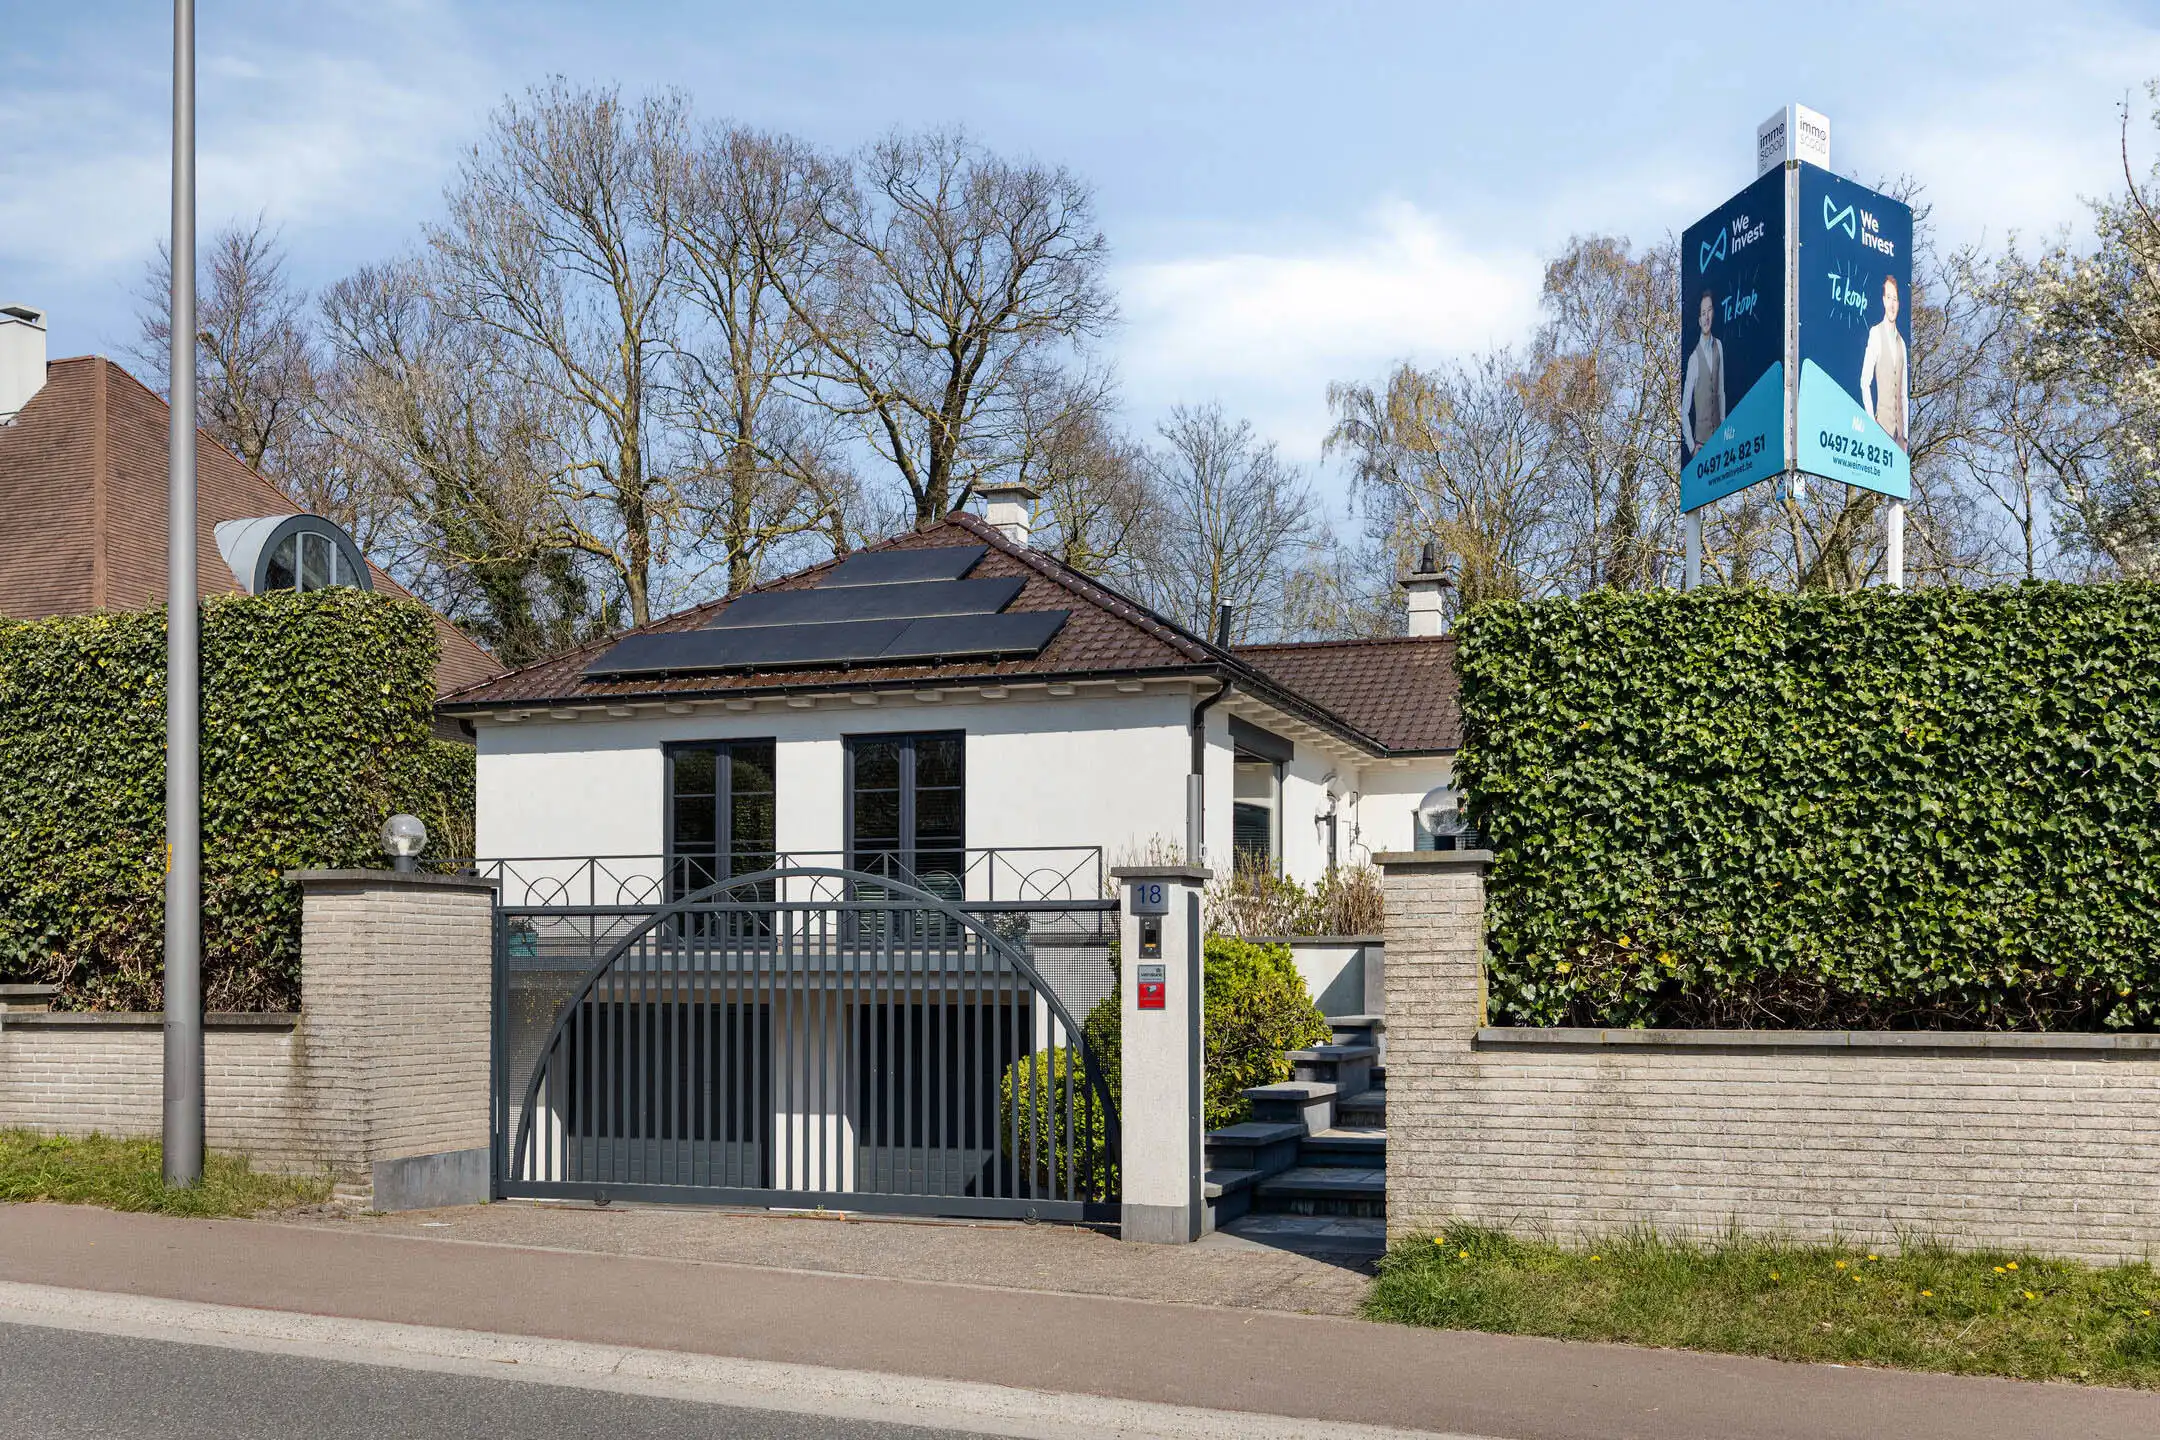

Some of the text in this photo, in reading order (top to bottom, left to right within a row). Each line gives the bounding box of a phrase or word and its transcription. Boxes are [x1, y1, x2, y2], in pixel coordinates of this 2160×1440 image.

[1760, 122, 1785, 149] immo
[1799, 114, 1827, 141] immo
[1760, 136, 1785, 162] scoop
[1732, 214, 1750, 237] We
[1860, 209, 1879, 233] We
[1731, 222, 1765, 255] Invest
[1861, 227, 1895, 257] Invest
[1721, 287, 1758, 325] Te koop
[1827, 272, 1868, 317] Te koop
[1697, 432, 1766, 479] 0497 24 82 51
[1819, 430, 1894, 469] 0497 24 82 51
[1708, 461, 1753, 487] www.weinvest.be
[1832, 456, 1881, 477] www.weinvest.be
[1136, 884, 1162, 905] 18
